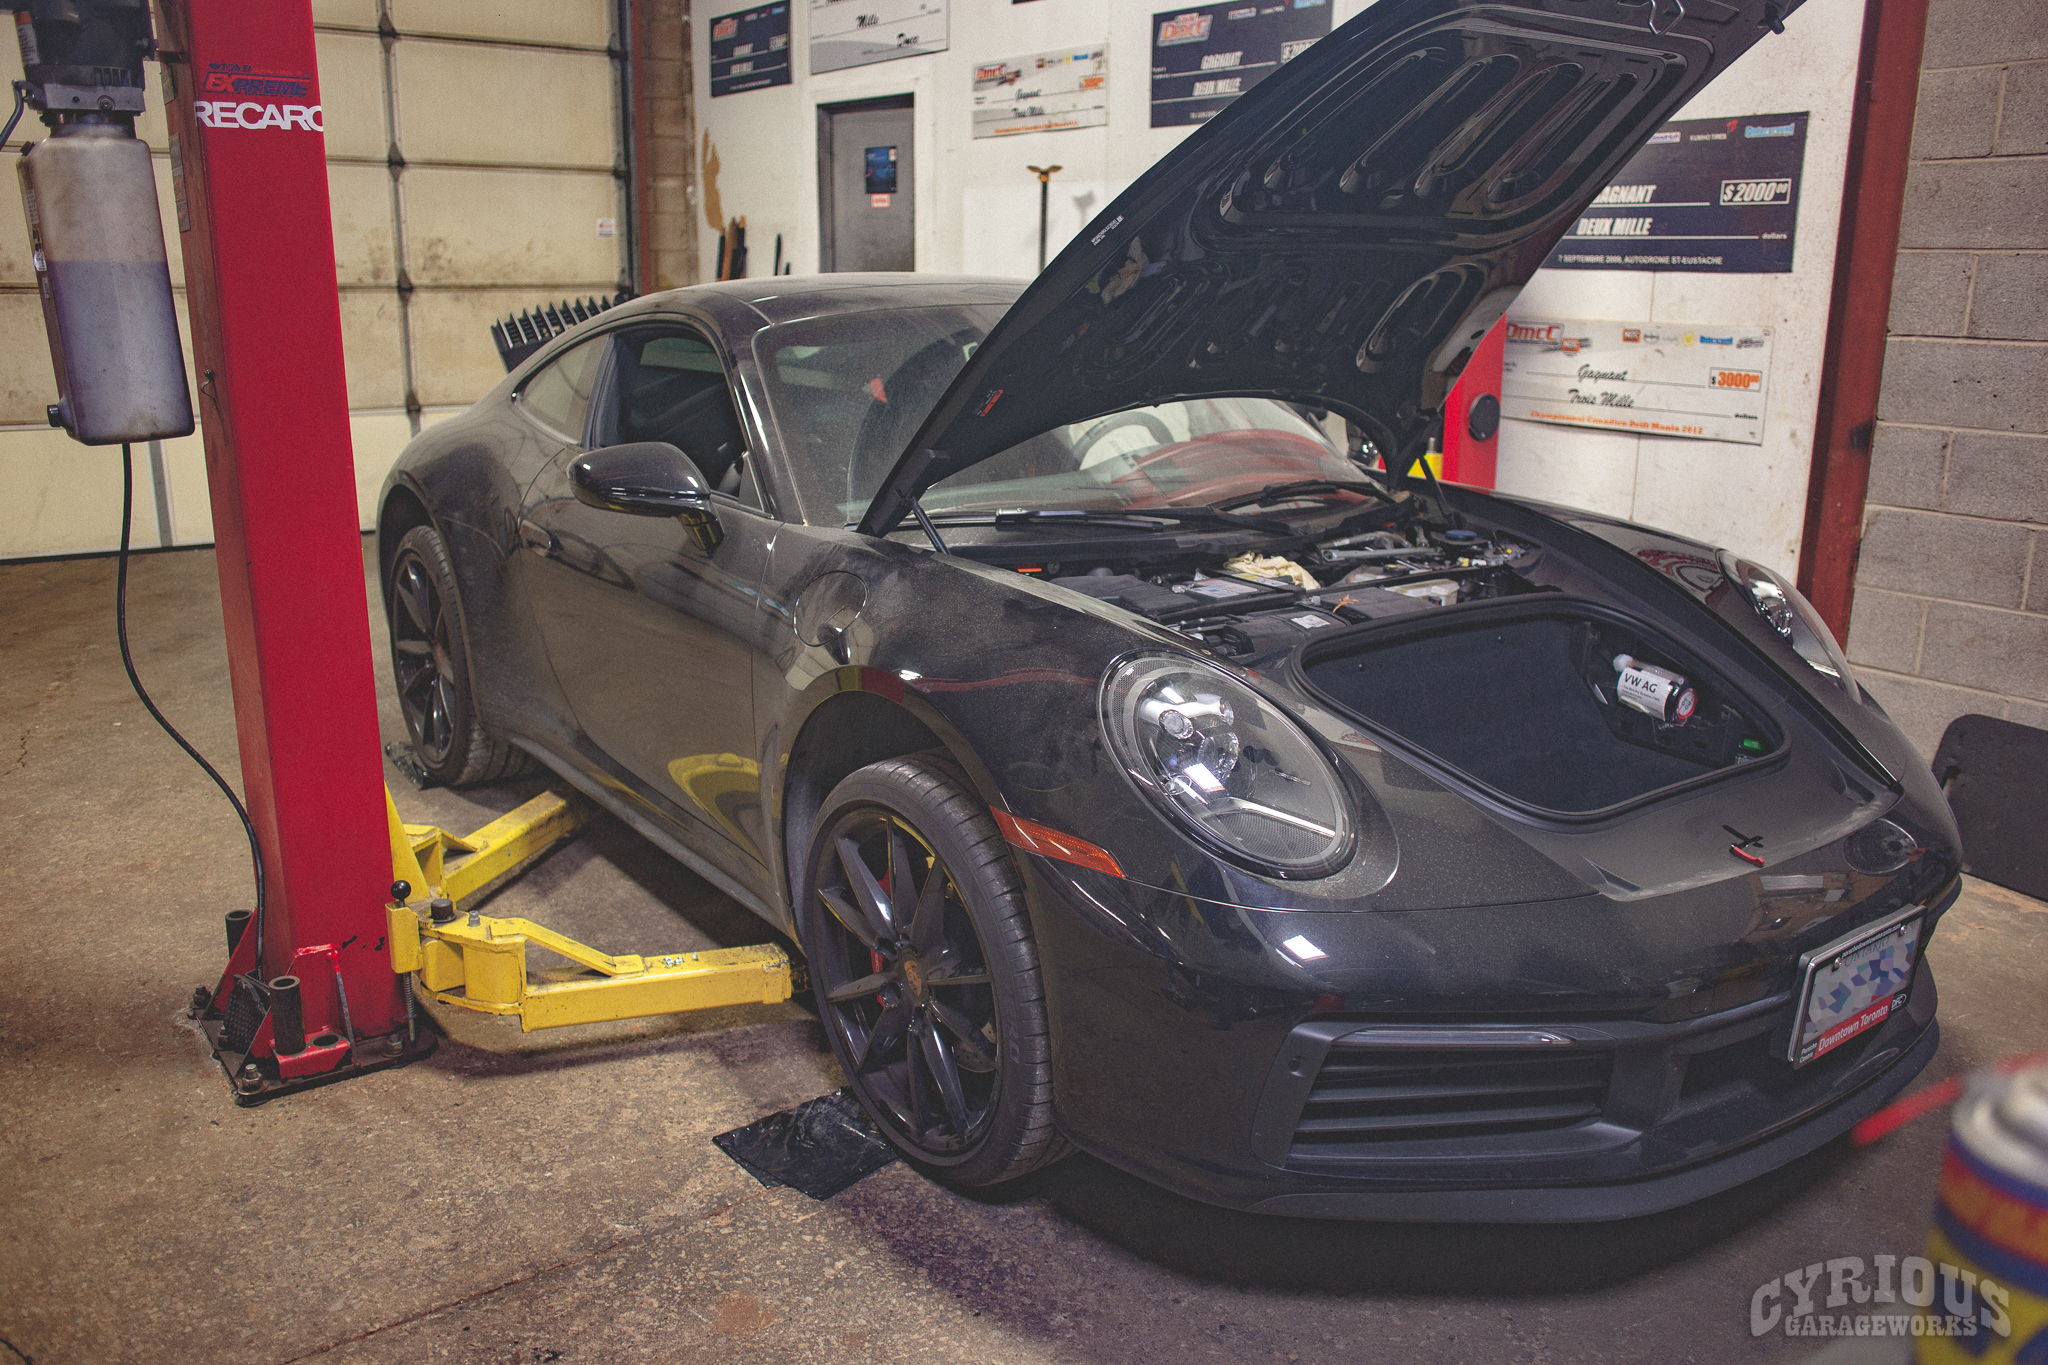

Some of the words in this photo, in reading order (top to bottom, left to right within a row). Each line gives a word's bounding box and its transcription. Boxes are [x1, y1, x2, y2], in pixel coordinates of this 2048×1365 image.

[204, 73, 308, 97] EXPREME
[1592, 185, 1657, 203] AGNANT
[1575, 218, 1613, 236] DEUX
[1612, 218, 1653, 236] MILLE
[1762, 232, 1788, 240] dollars
[1564, 255, 1604, 264] SEPTEMBRE
[1568, 389, 1597, 405] Trois
[1600, 392, 1635, 408] Mille
[1682, 426, 1704, 435] 2012
[1625, 673, 1642, 687] VW
[1642, 680, 1658, 694] AG
[1818, 1021, 1860, 1052] Downtown
[1860, 1005, 1889, 1027] Toronto
